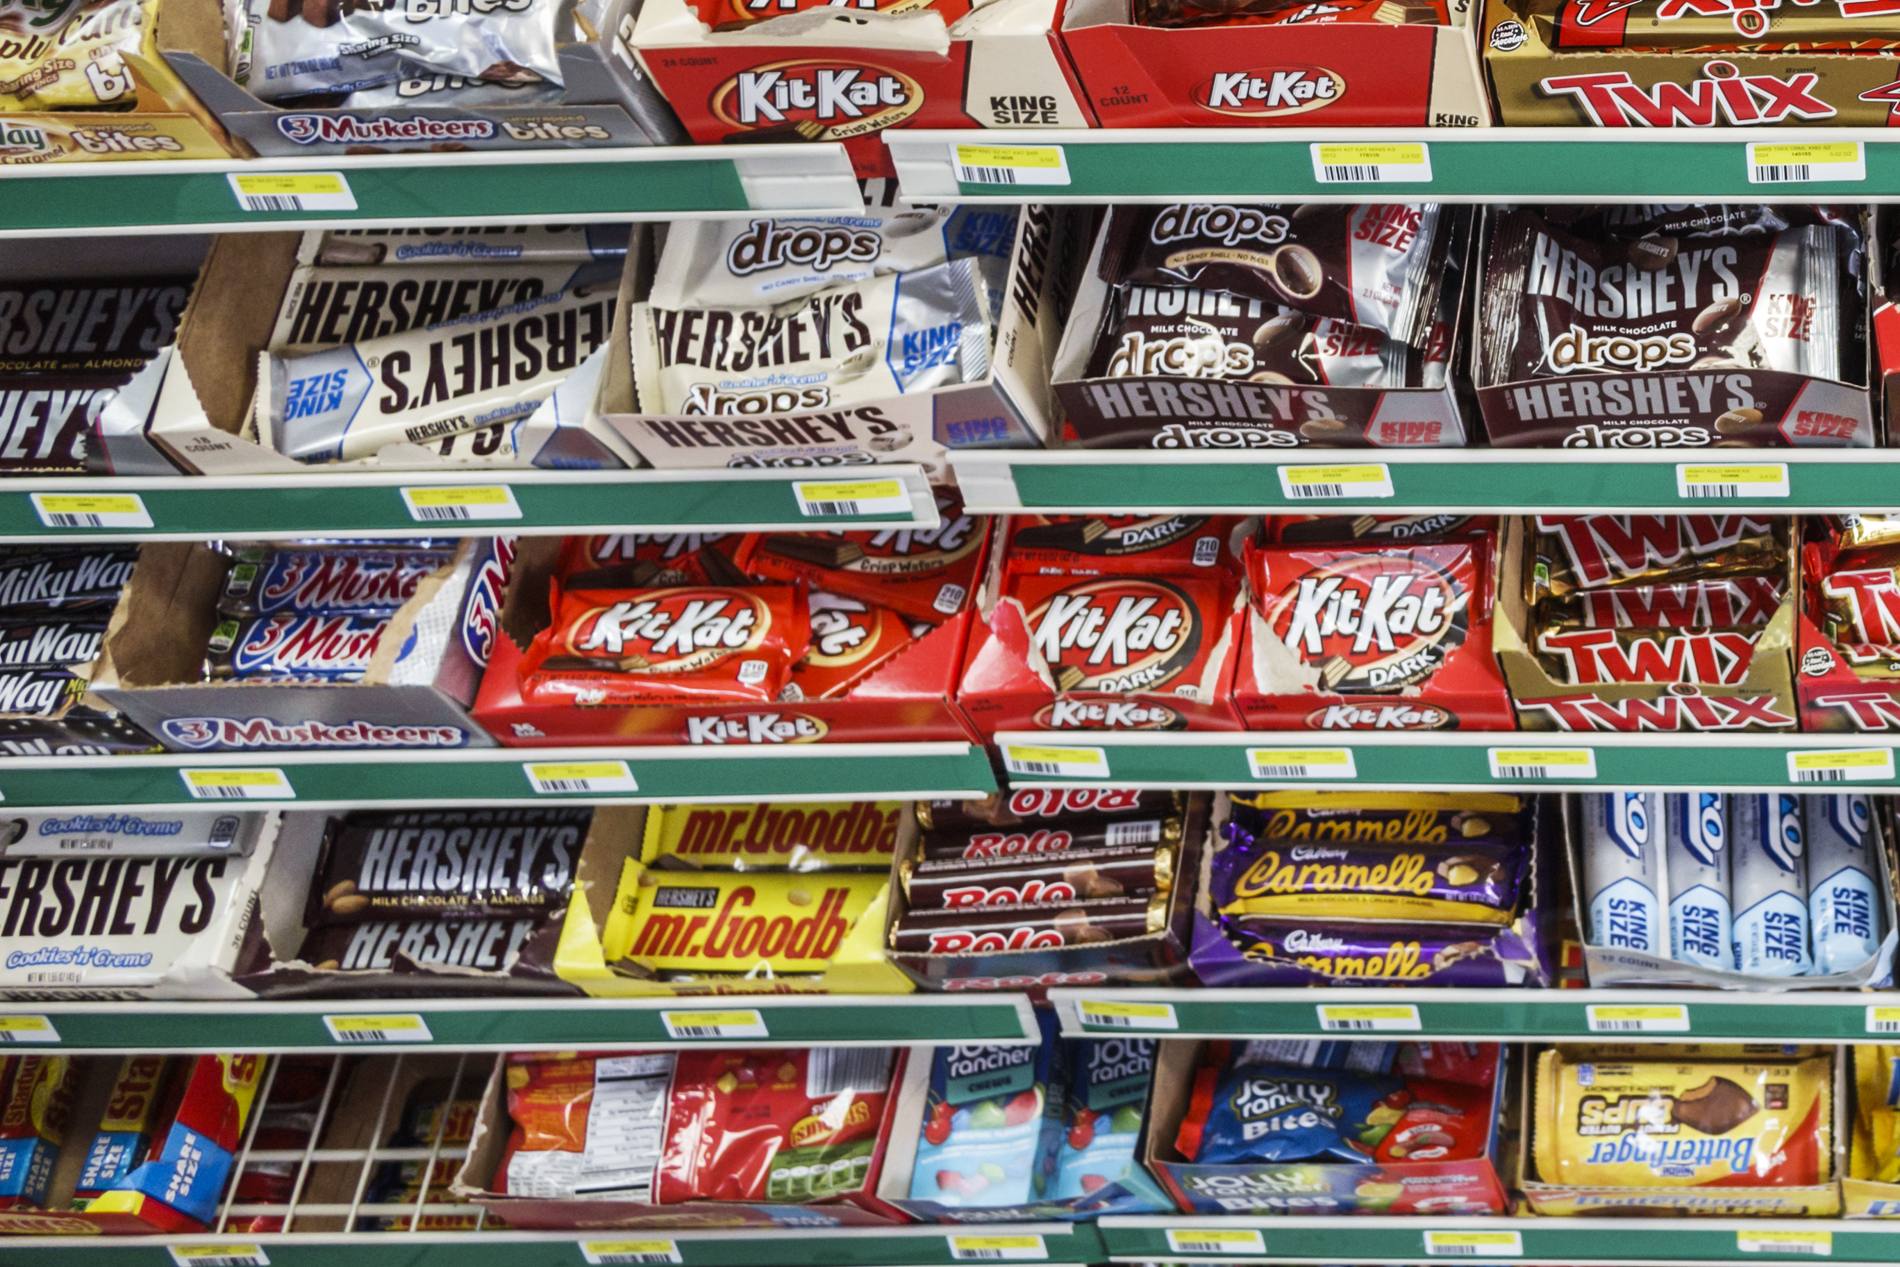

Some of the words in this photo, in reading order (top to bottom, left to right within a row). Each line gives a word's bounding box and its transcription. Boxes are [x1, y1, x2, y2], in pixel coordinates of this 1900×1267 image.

[991, 95, 1056, 110] KING
[993, 108, 1059, 125] SIZE
[295, 118, 312, 137] 3
[319, 117, 492, 141] Musketeers
[1549, 329, 1697, 372] drops
[646, 405, 900, 451] HERSHEY'S
[1367, 649, 1436, 686] DARK
[357, 818, 580, 891] HERSHEY'S
[1235, 850, 1435, 899] Caramello
[655, 888, 718, 907] HERSHEY'S
